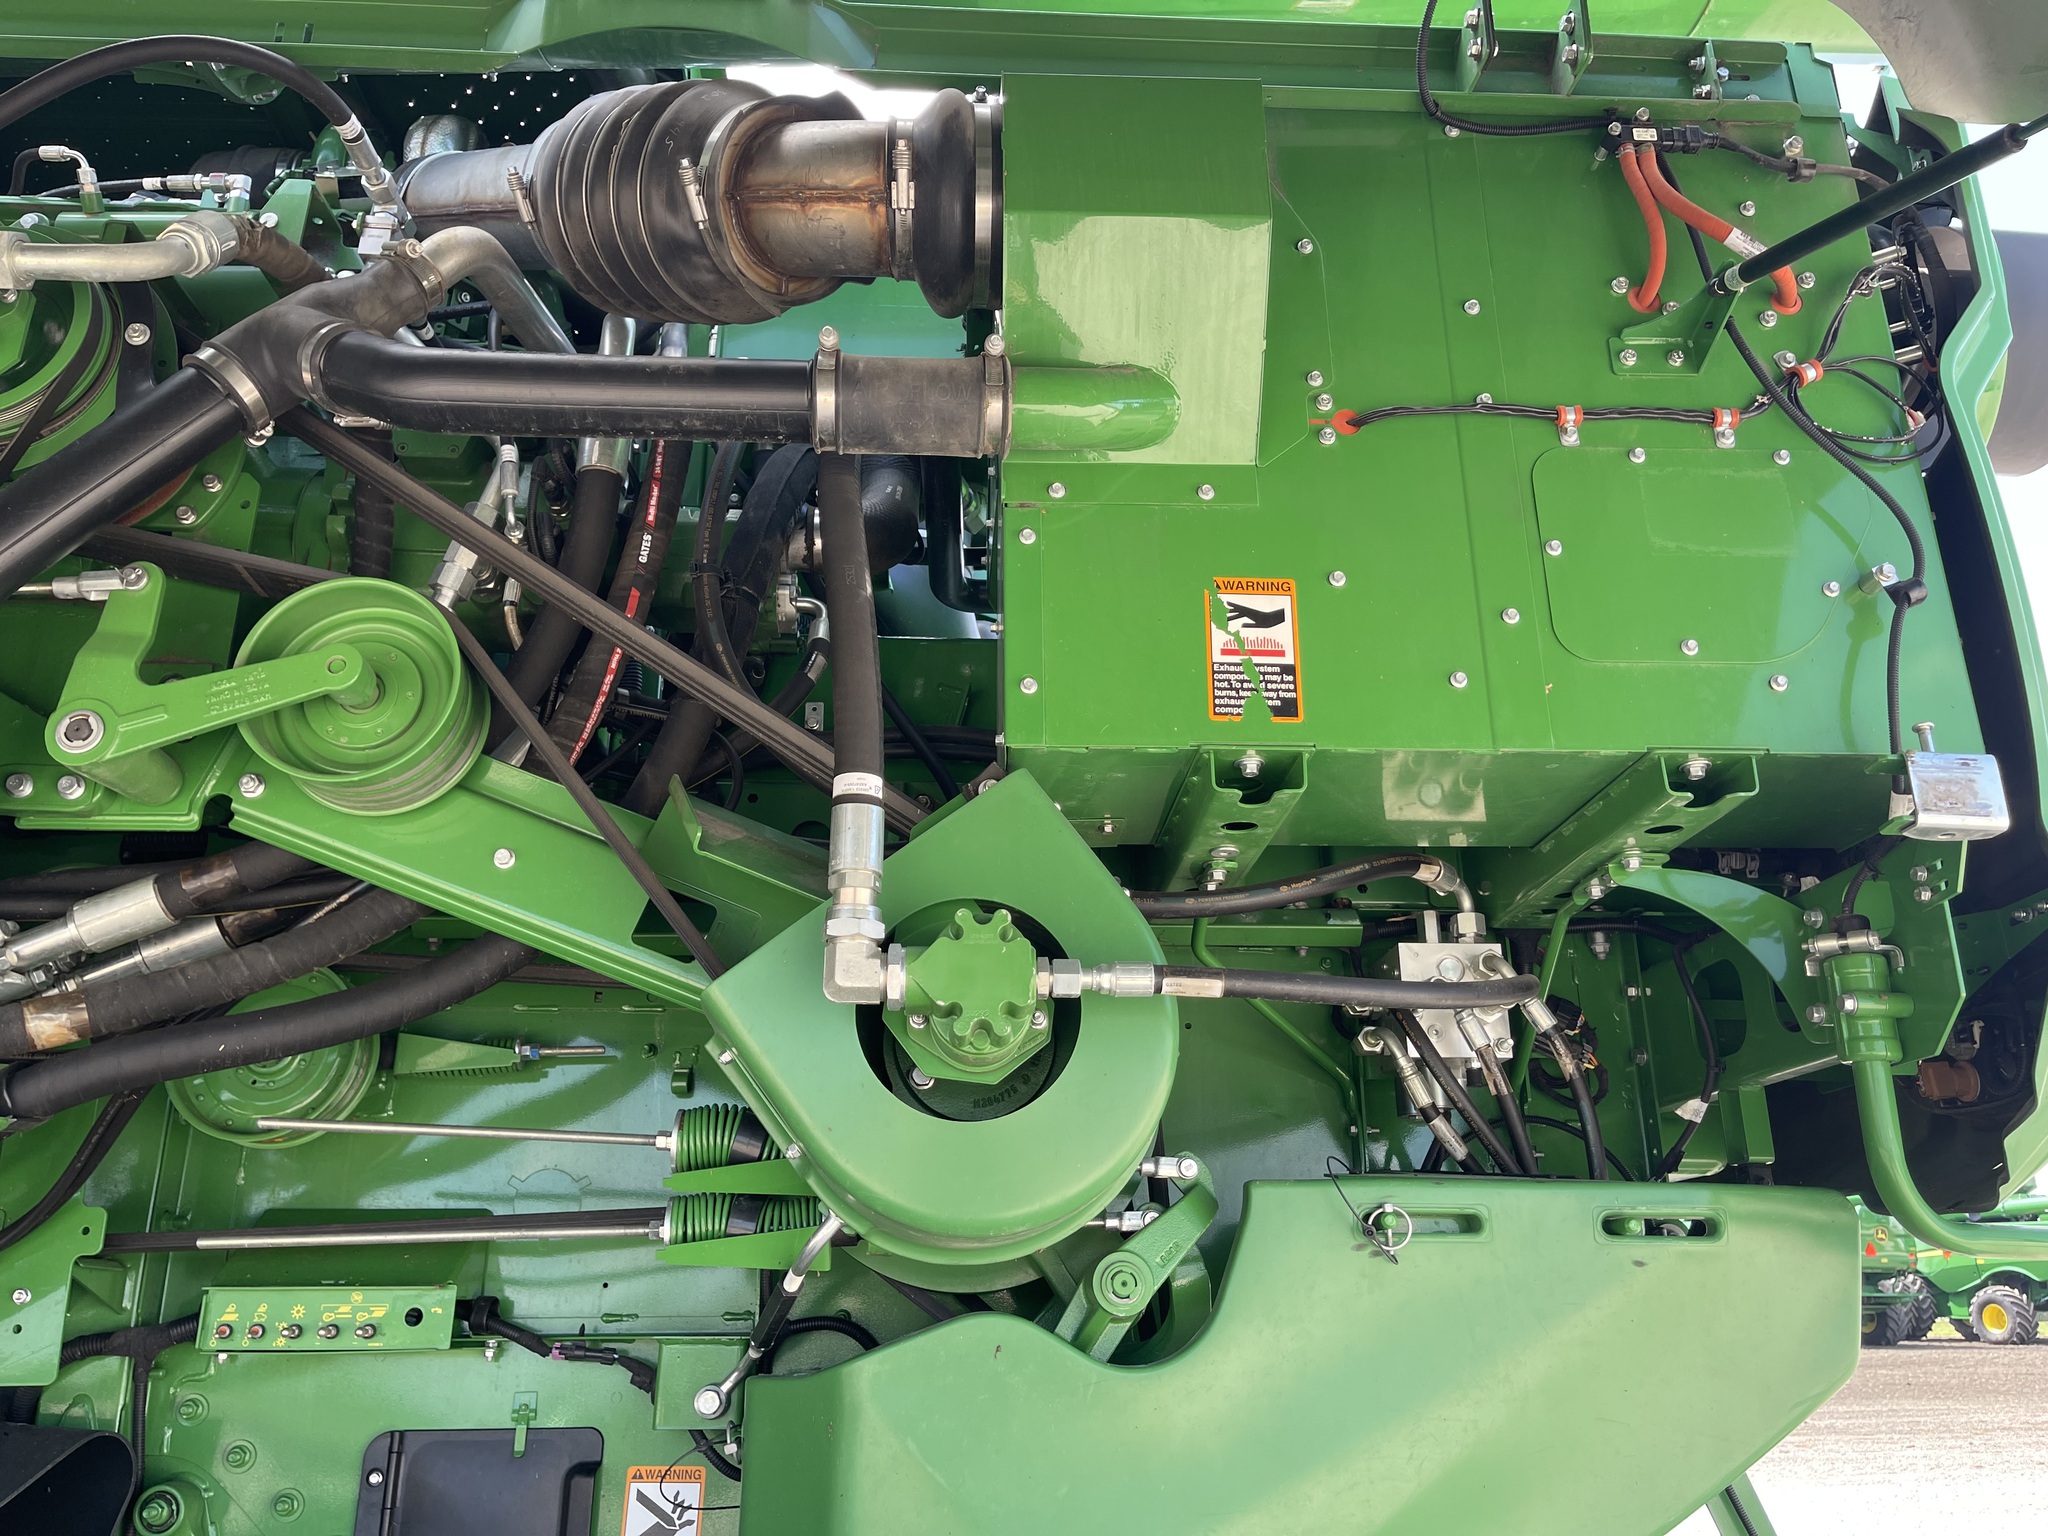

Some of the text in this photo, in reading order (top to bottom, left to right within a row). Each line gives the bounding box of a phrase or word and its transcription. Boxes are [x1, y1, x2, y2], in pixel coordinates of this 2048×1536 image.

[639, 533, 652, 563] GATES
[1223, 580, 1291, 592] WARNING
[1264, 674, 1282, 683] may
[1231, 680, 1241, 688] To
[1214, 689, 1239, 697] burns,
[645, 1469, 702, 1480] WARNING
